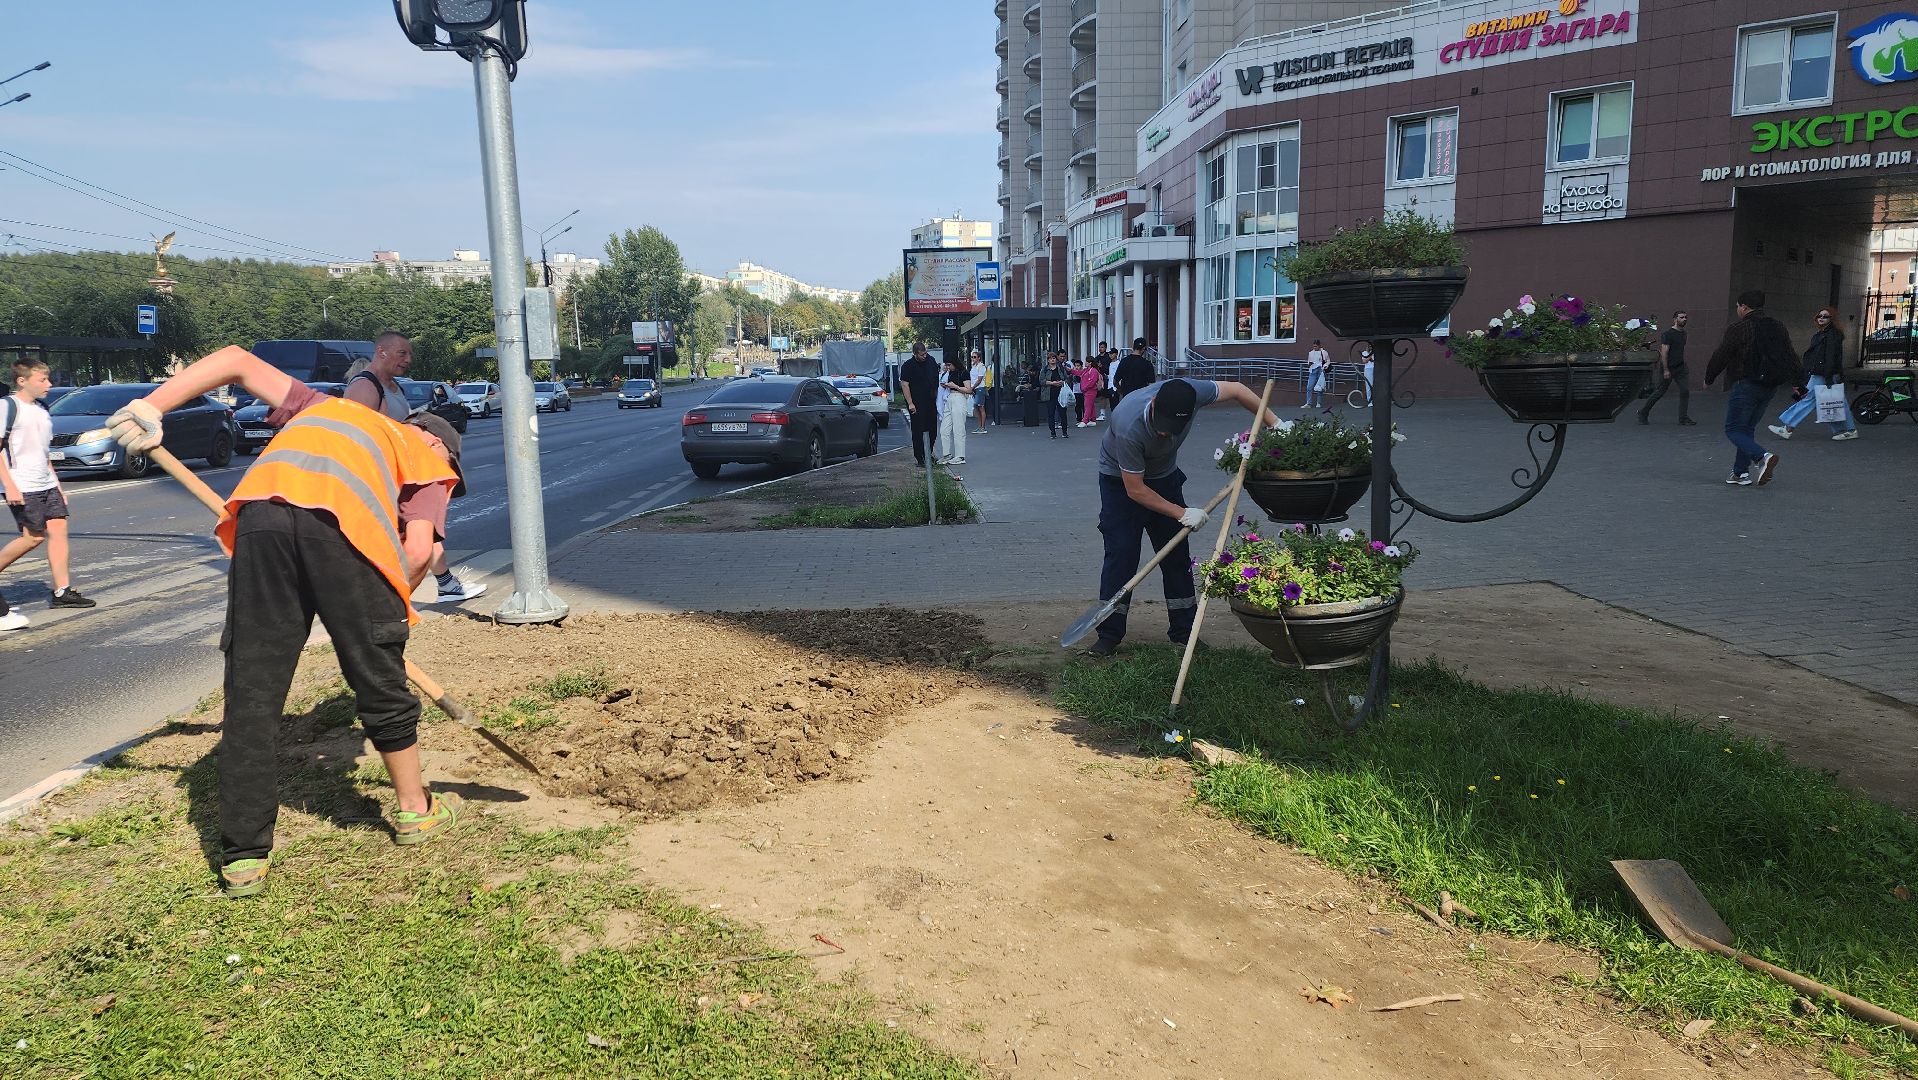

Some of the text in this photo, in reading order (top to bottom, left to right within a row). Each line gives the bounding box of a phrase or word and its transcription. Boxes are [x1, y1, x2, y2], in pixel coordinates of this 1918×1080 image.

[1439, 11, 1630, 64] СТУДИЯ ЗАГАРА
[1465, 10, 1550, 38] ВИТАМИН
[1273, 36, 1413, 78] VISION REPAIR
[1235, 66, 1264, 96] VR
[1272, 59, 1414, 92] РЕМОНТ МОБИЛЬНОЙ ТЕХНИКИ
[1701, 150, 1912, 182] ЛОР И СТОМАТОЛОГИЯ ДЛЯ
[1542, 195, 1623, 214] на Чехова
[1561, 184, 1606, 197] Класс
